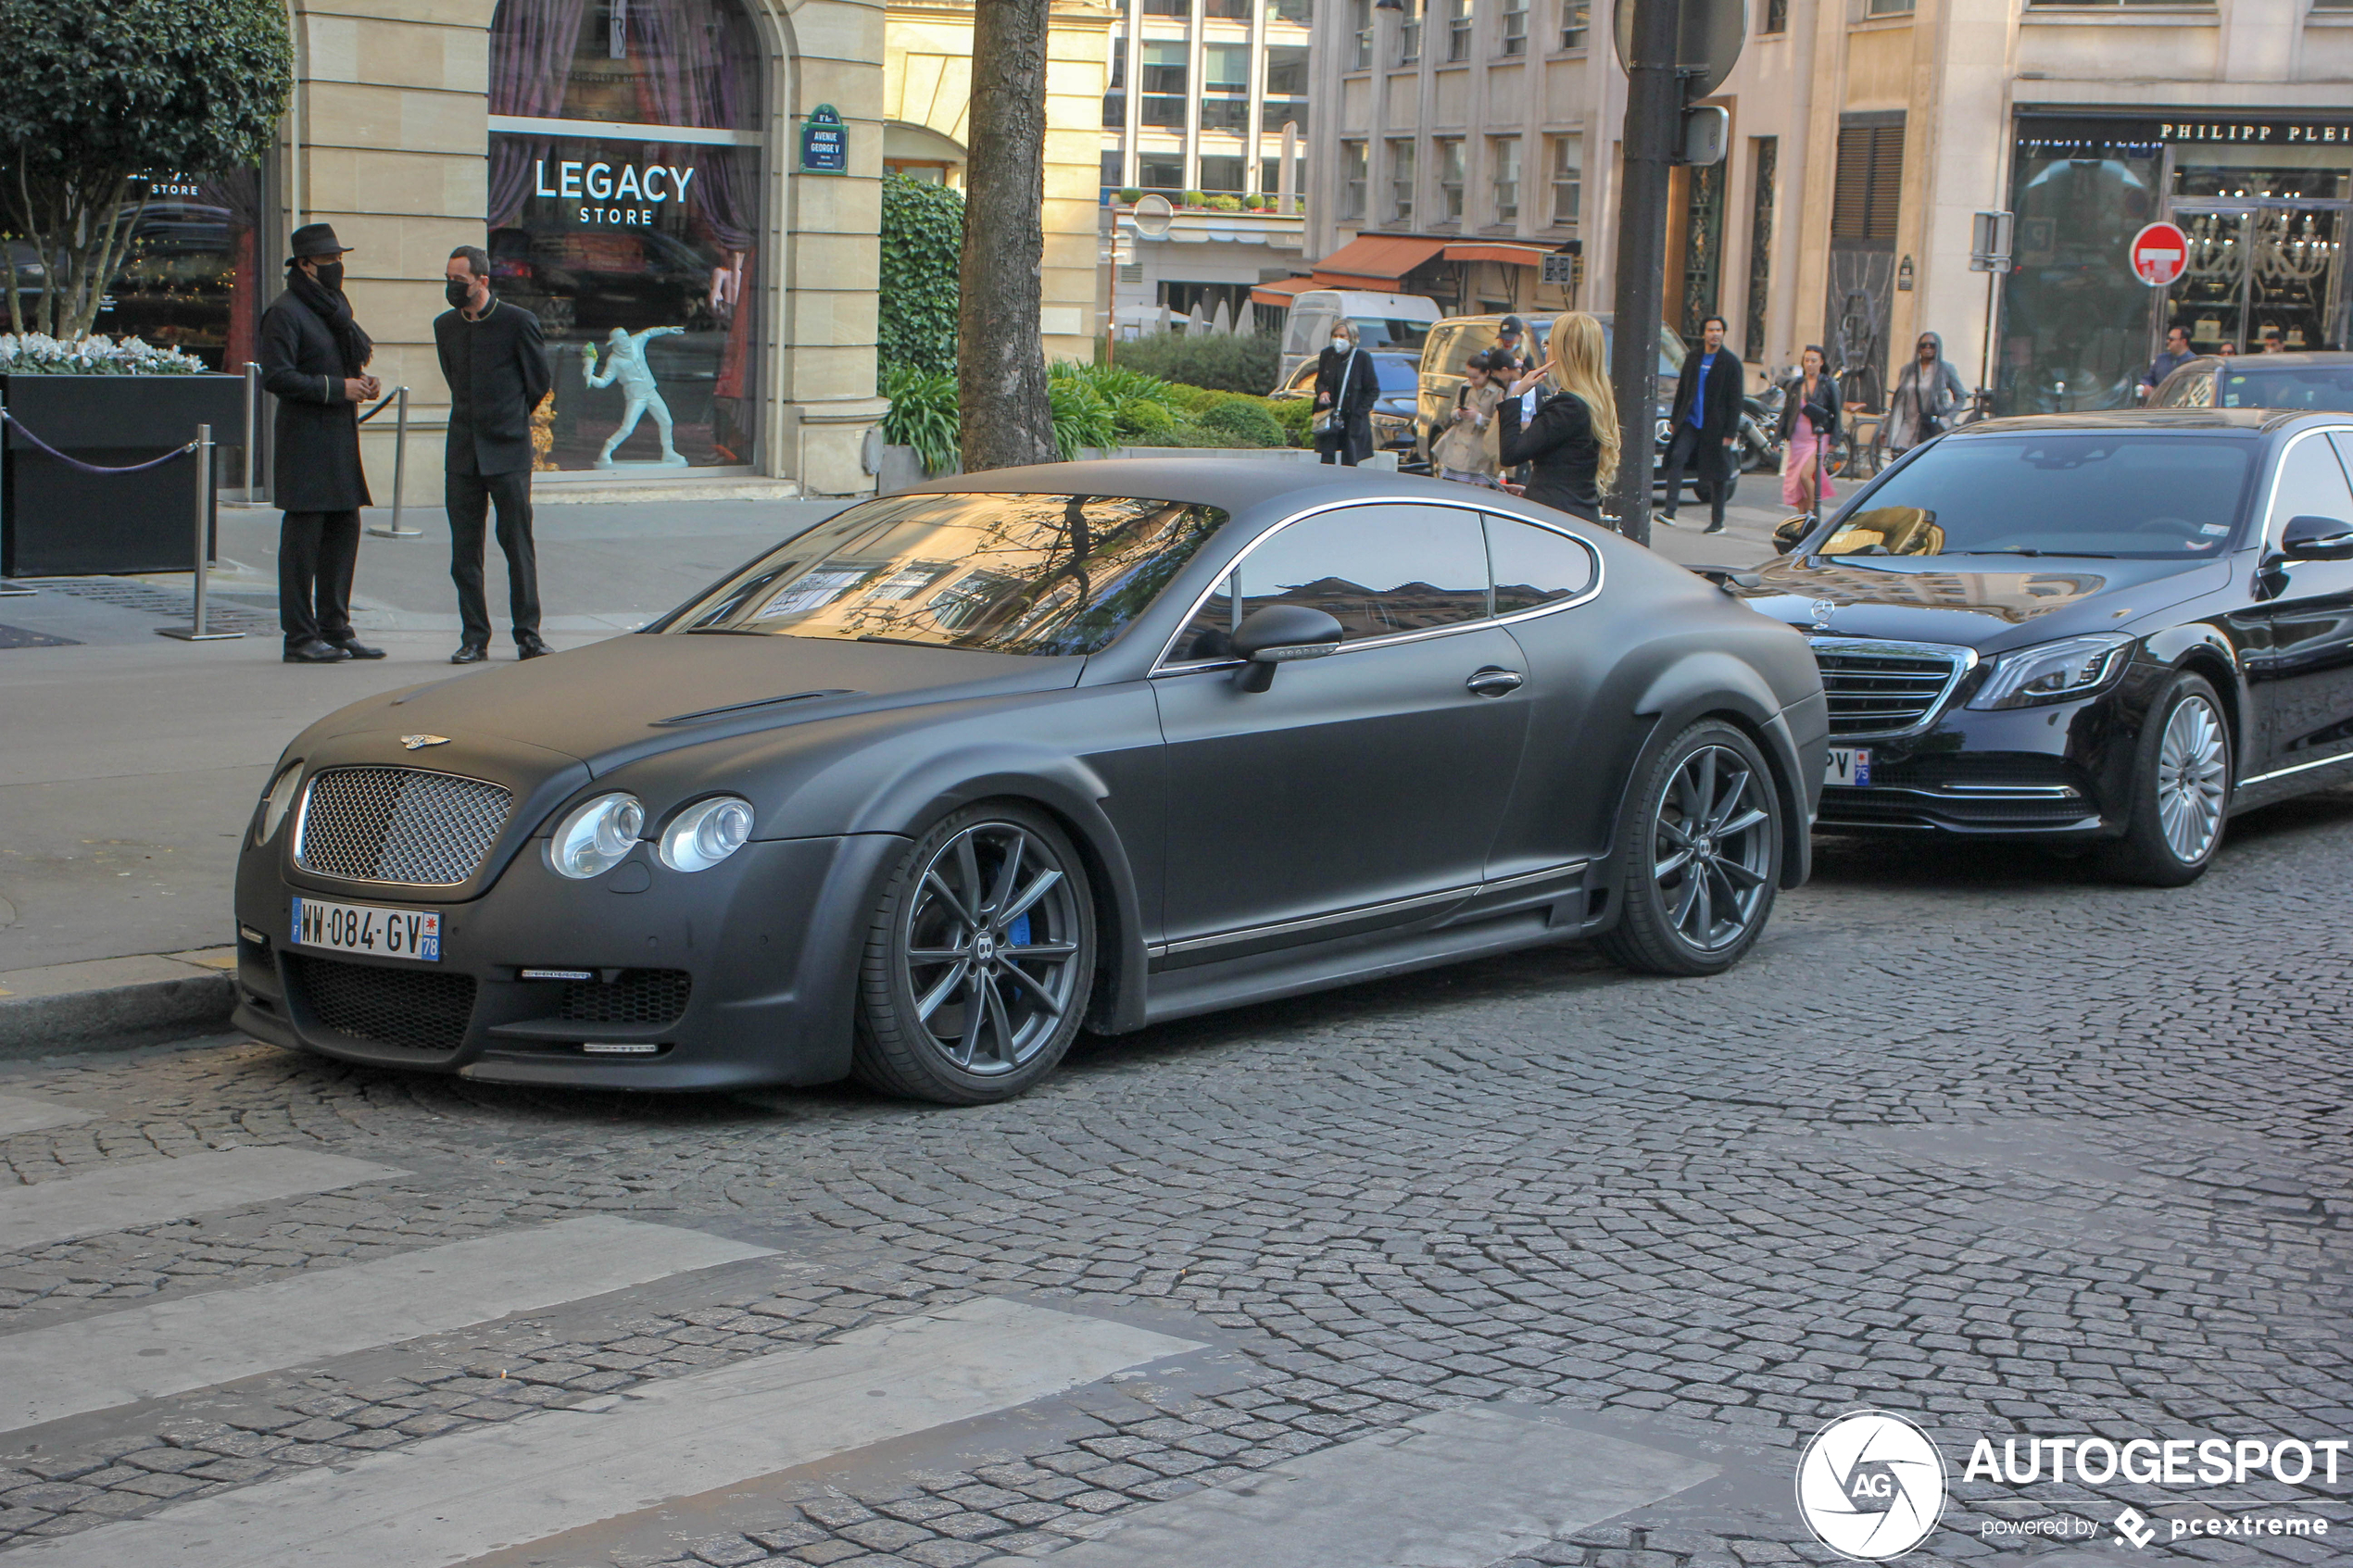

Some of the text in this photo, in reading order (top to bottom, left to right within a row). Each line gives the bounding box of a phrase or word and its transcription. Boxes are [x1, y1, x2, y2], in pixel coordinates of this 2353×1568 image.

[814, 131, 838, 143] AVENUE
[2159, 123, 2271, 141] PHILIPP
[811, 143, 840, 154] GEORGE V
[535, 159, 695, 204] LEGACY
[152, 183, 198, 196] STORE
[579, 207, 652, 226] STORE
[1856, 767, 1869, 780] 75
[294, 924, 299, 935] F
[423, 937, 438, 956] 78
